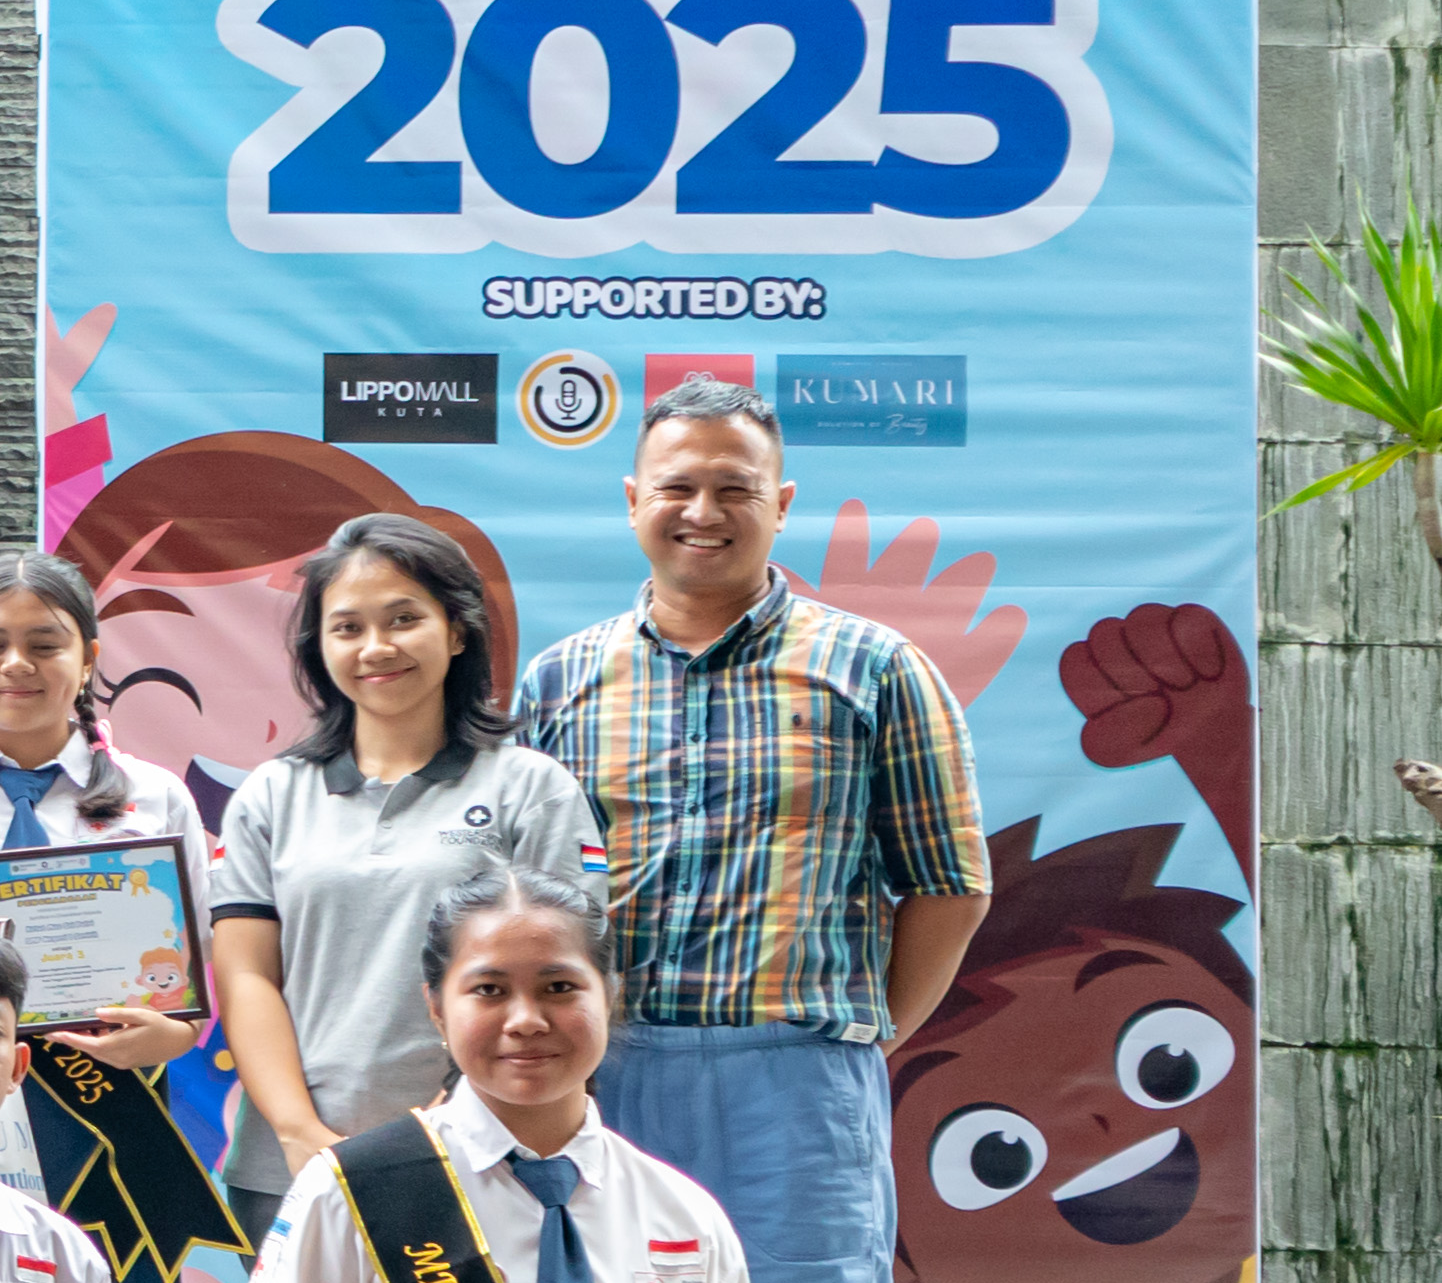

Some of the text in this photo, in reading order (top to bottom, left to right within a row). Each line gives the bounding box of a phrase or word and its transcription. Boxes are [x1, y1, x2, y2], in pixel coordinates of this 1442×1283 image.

[483, 276, 825, 320] SUPPORTED BY:
[794, 378, 953, 406] KUMARI
[378, 407, 443, 417] KUTA
[53, 1048, 114, 1105] 2025
